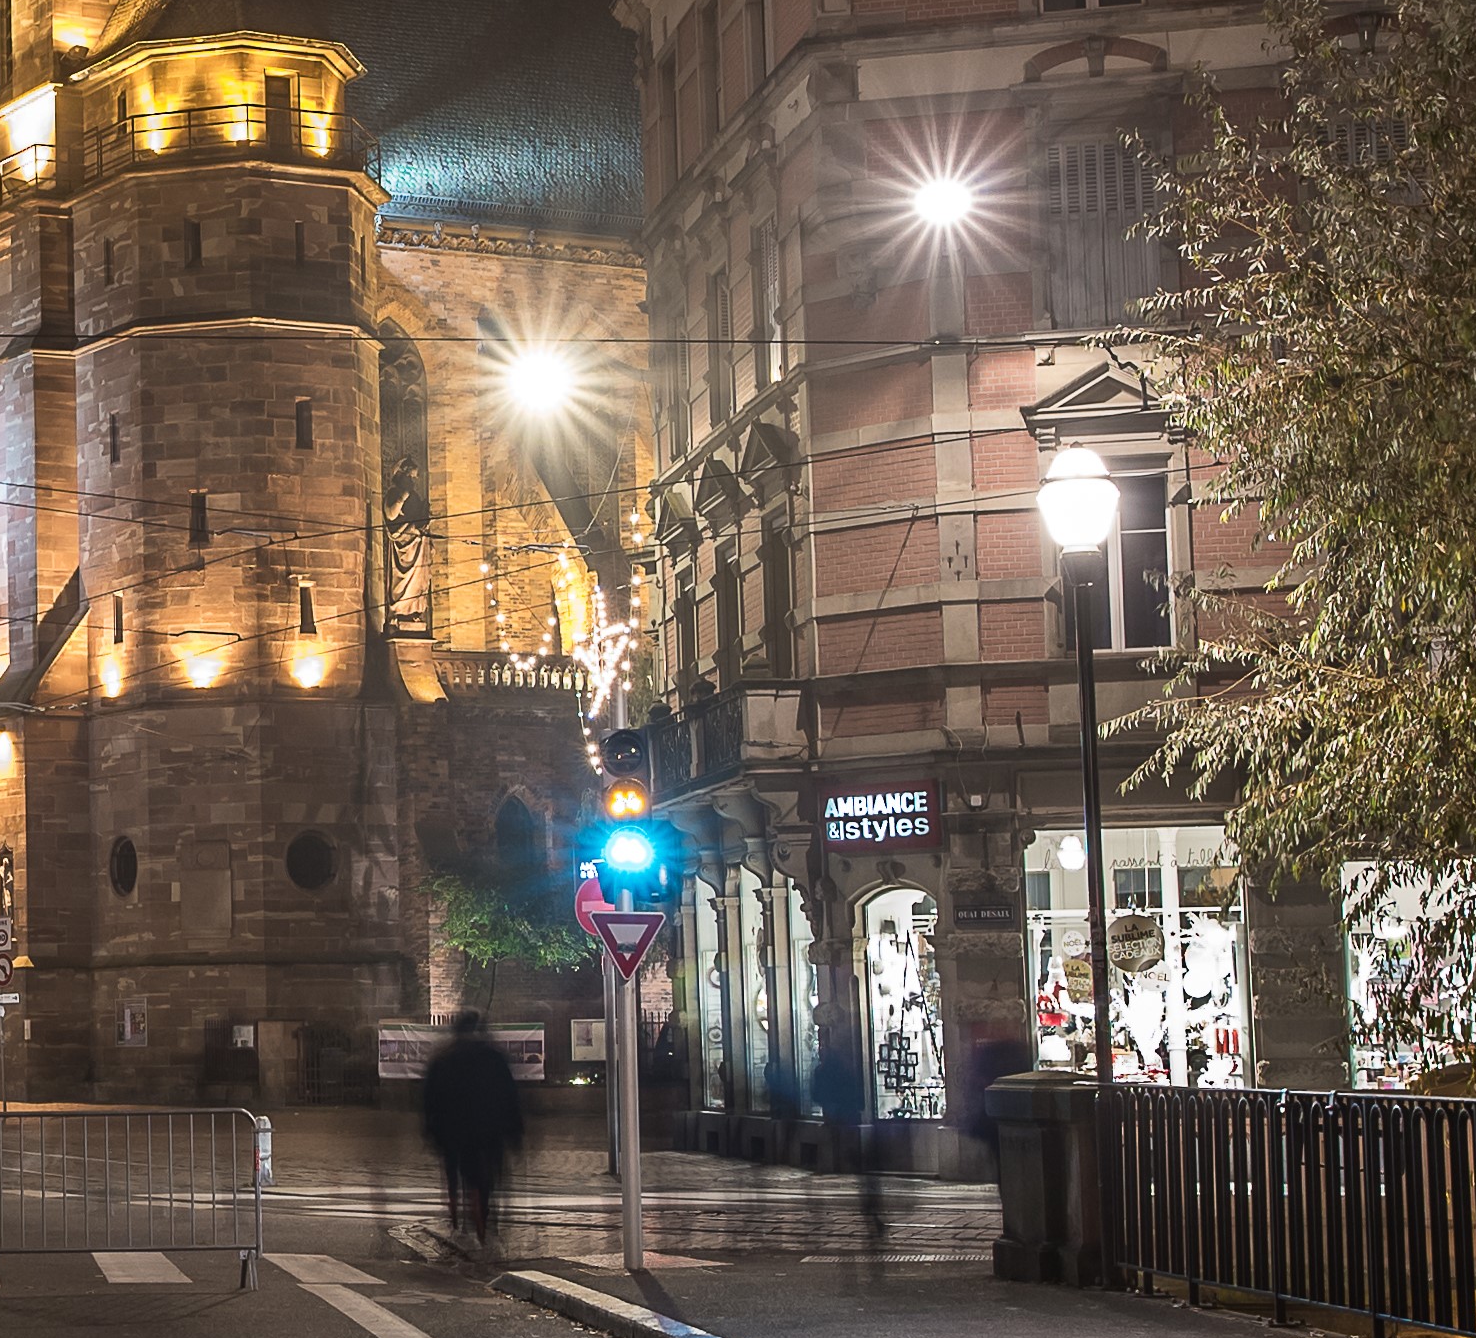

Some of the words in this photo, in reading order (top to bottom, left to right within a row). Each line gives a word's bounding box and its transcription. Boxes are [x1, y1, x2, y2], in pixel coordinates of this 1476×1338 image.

[824, 791, 928, 818] AMBIANCE
[958, 911, 979, 919] QUAI
[1124, 924, 1139, 932] LA
[1111, 929, 1156, 943] SUBLIME
[1111, 946, 1163, 962] CADEAUX
